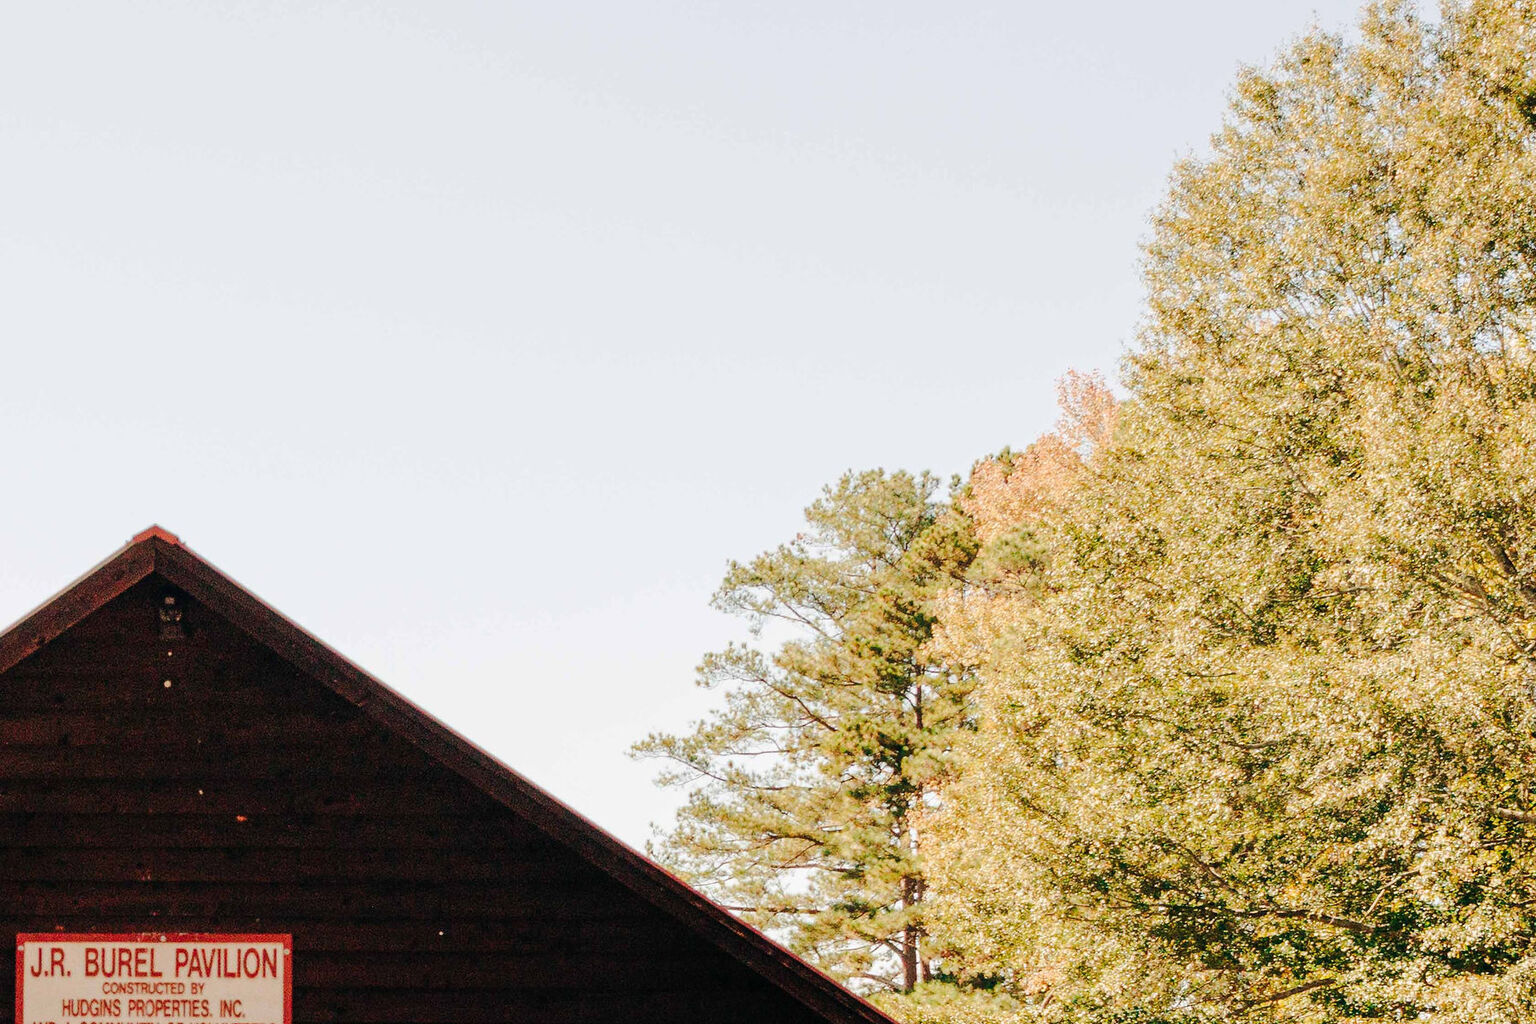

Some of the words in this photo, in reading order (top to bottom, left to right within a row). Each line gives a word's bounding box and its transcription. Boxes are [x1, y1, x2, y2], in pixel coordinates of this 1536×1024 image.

[30, 948, 71, 978] J.R.
[84, 948, 162, 978] BUREL
[175, 948, 277, 978] PAVILION
[102, 983, 184, 994] CONSTRUCTED
[190, 982, 205, 995] BY
[62, 999, 121, 1018] HUDGINS
[219, 1000, 245, 1018] INC.
